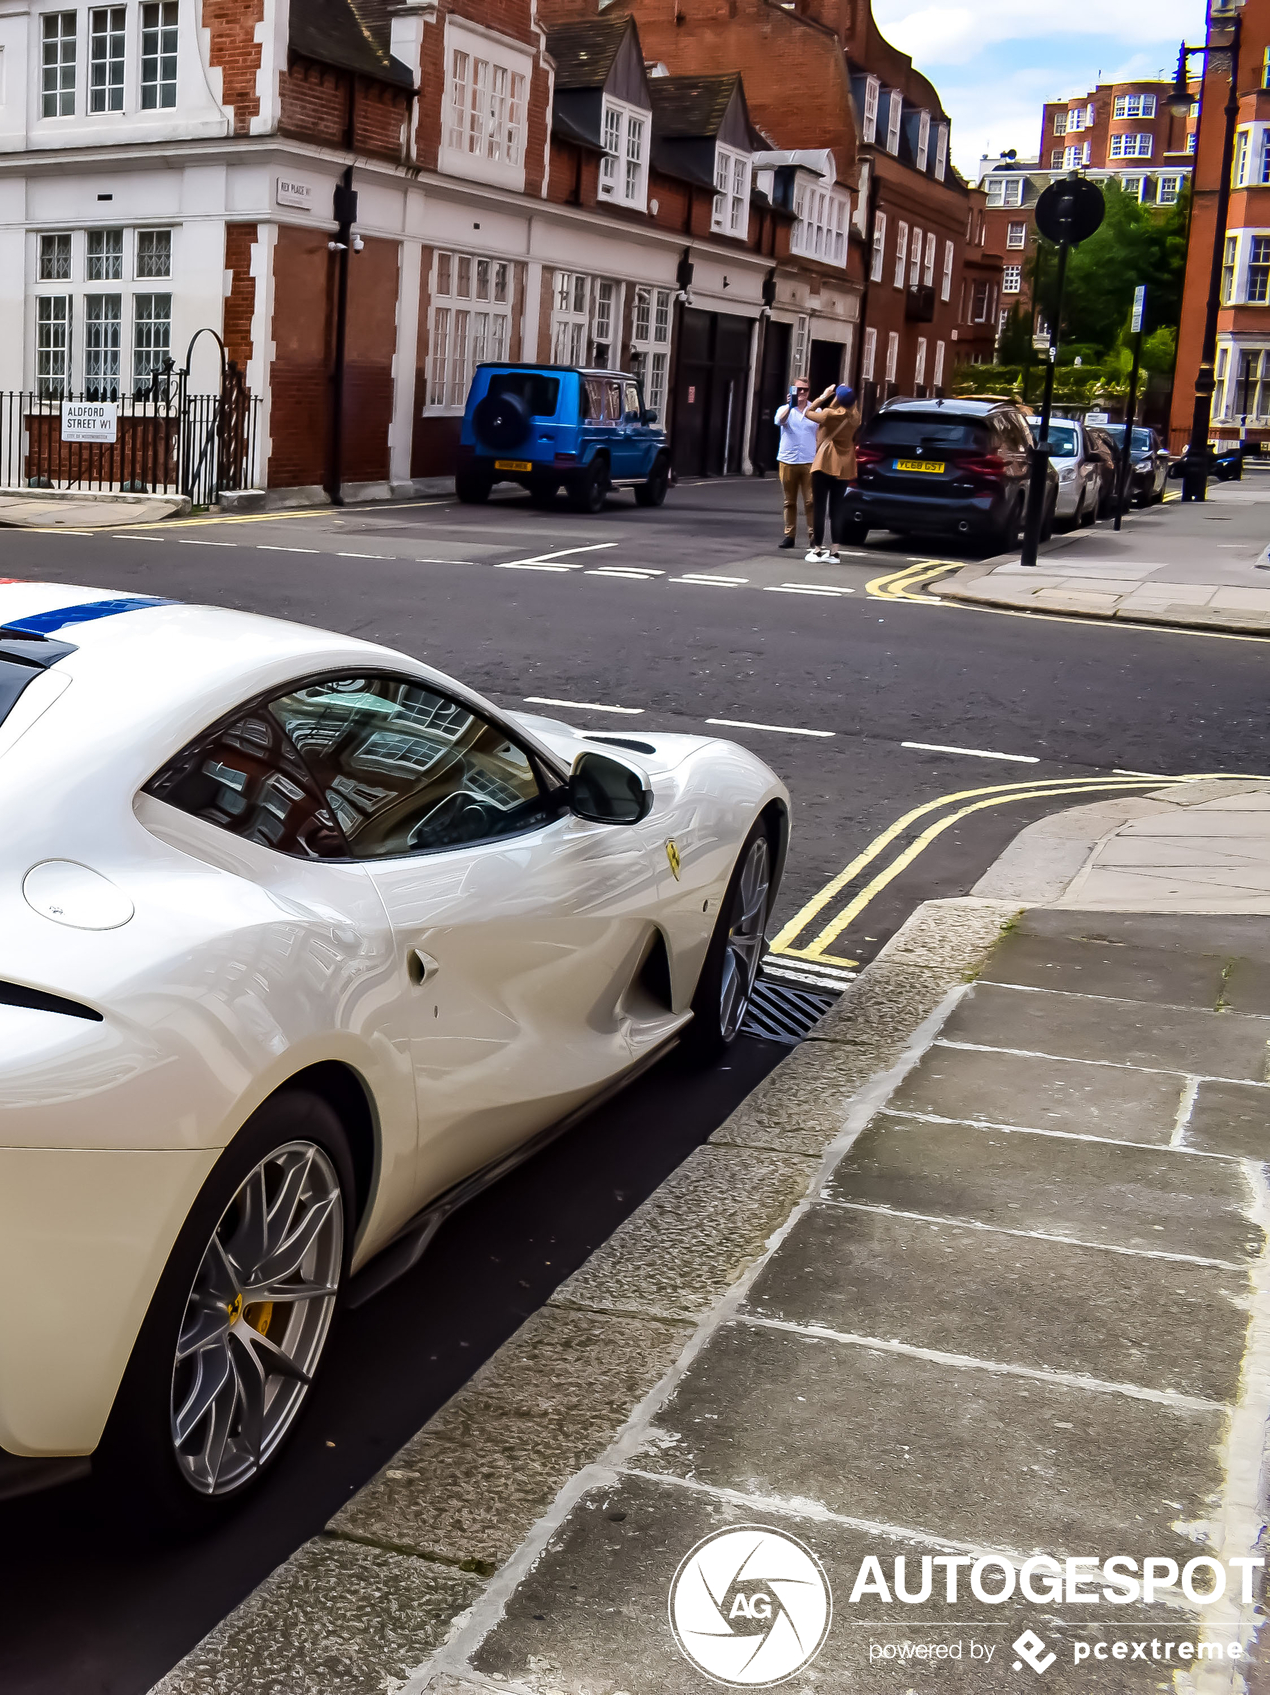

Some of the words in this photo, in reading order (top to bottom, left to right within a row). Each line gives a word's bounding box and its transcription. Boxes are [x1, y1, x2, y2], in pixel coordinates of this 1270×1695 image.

[67, 407, 105, 417] ALDFORD
[67, 418, 97, 429] STREET
[99, 419, 111, 429] W1
